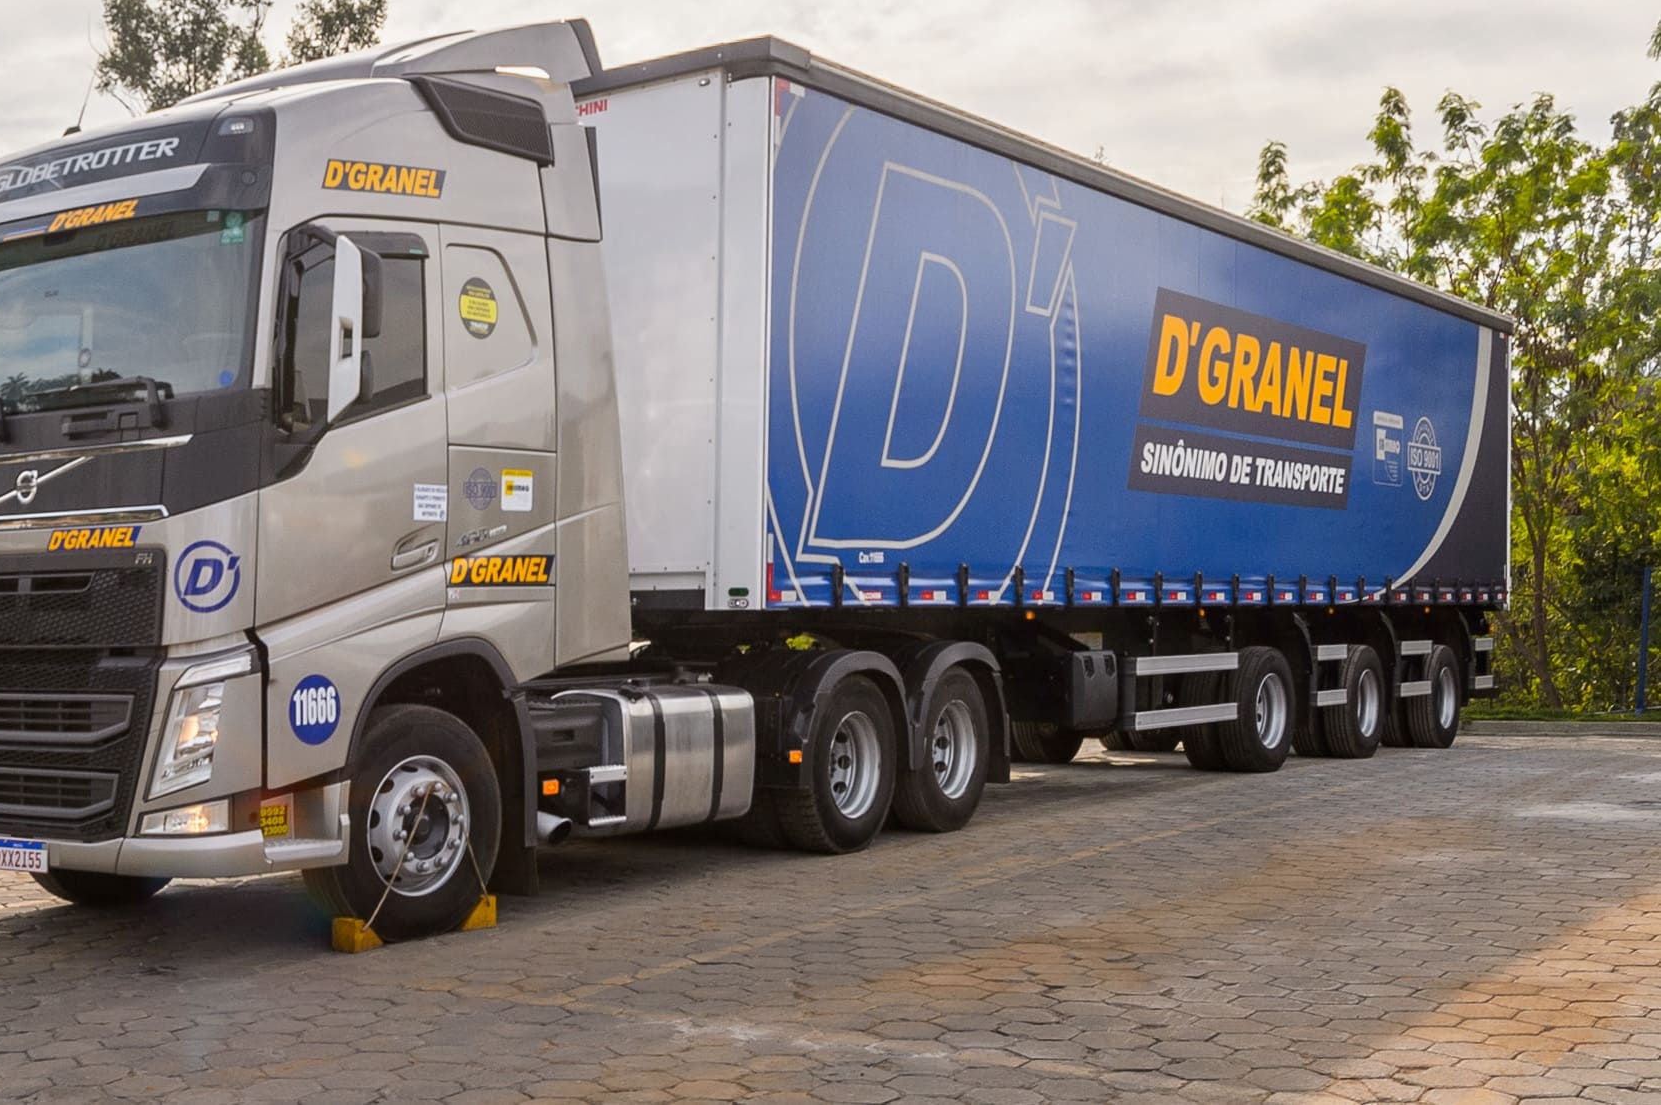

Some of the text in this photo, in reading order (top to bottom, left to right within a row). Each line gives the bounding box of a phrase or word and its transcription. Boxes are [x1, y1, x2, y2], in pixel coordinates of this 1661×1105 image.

[575, 98, 608, 117] HINI
[324, 159, 440, 198] D'GRANEL
[47, 198, 139, 233] D'GRANEL
[1152, 313, 1353, 429] D'GRANEL
[1140, 439, 1228, 483] SINÔNIMO
[1229, 454, 1253, 485] DE
[1255, 457, 1346, 495] TRANSPORTE
[1410, 446, 1423, 467] ISO
[1423, 450, 1439, 470] 9001
[48, 526, 136, 552] D'GRANEL
[450, 556, 549, 584] D'GRANEL
[293, 685, 337, 727] 11666
